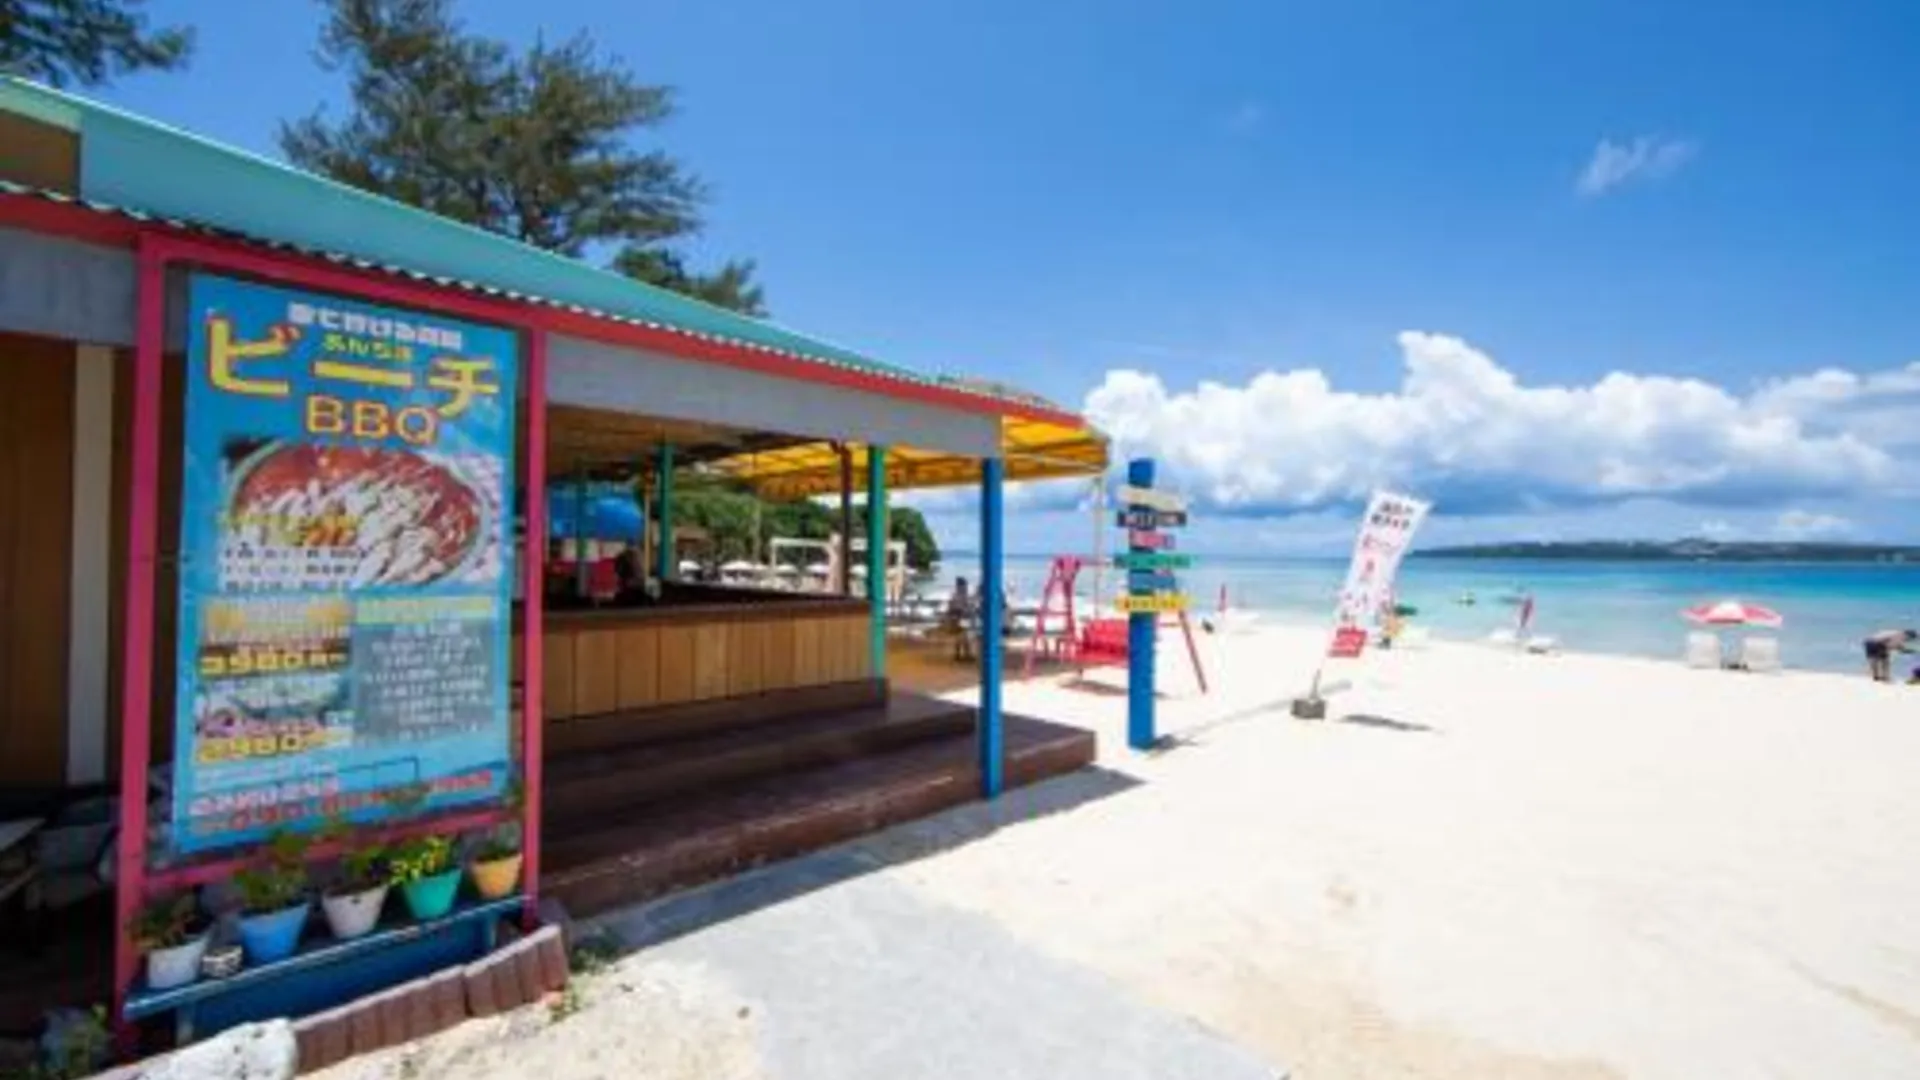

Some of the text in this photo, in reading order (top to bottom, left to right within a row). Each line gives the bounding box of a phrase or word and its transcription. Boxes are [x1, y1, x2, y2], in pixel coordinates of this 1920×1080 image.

[208, 317, 498, 417] ビーチ
[306, 395, 440, 444] BBQ
